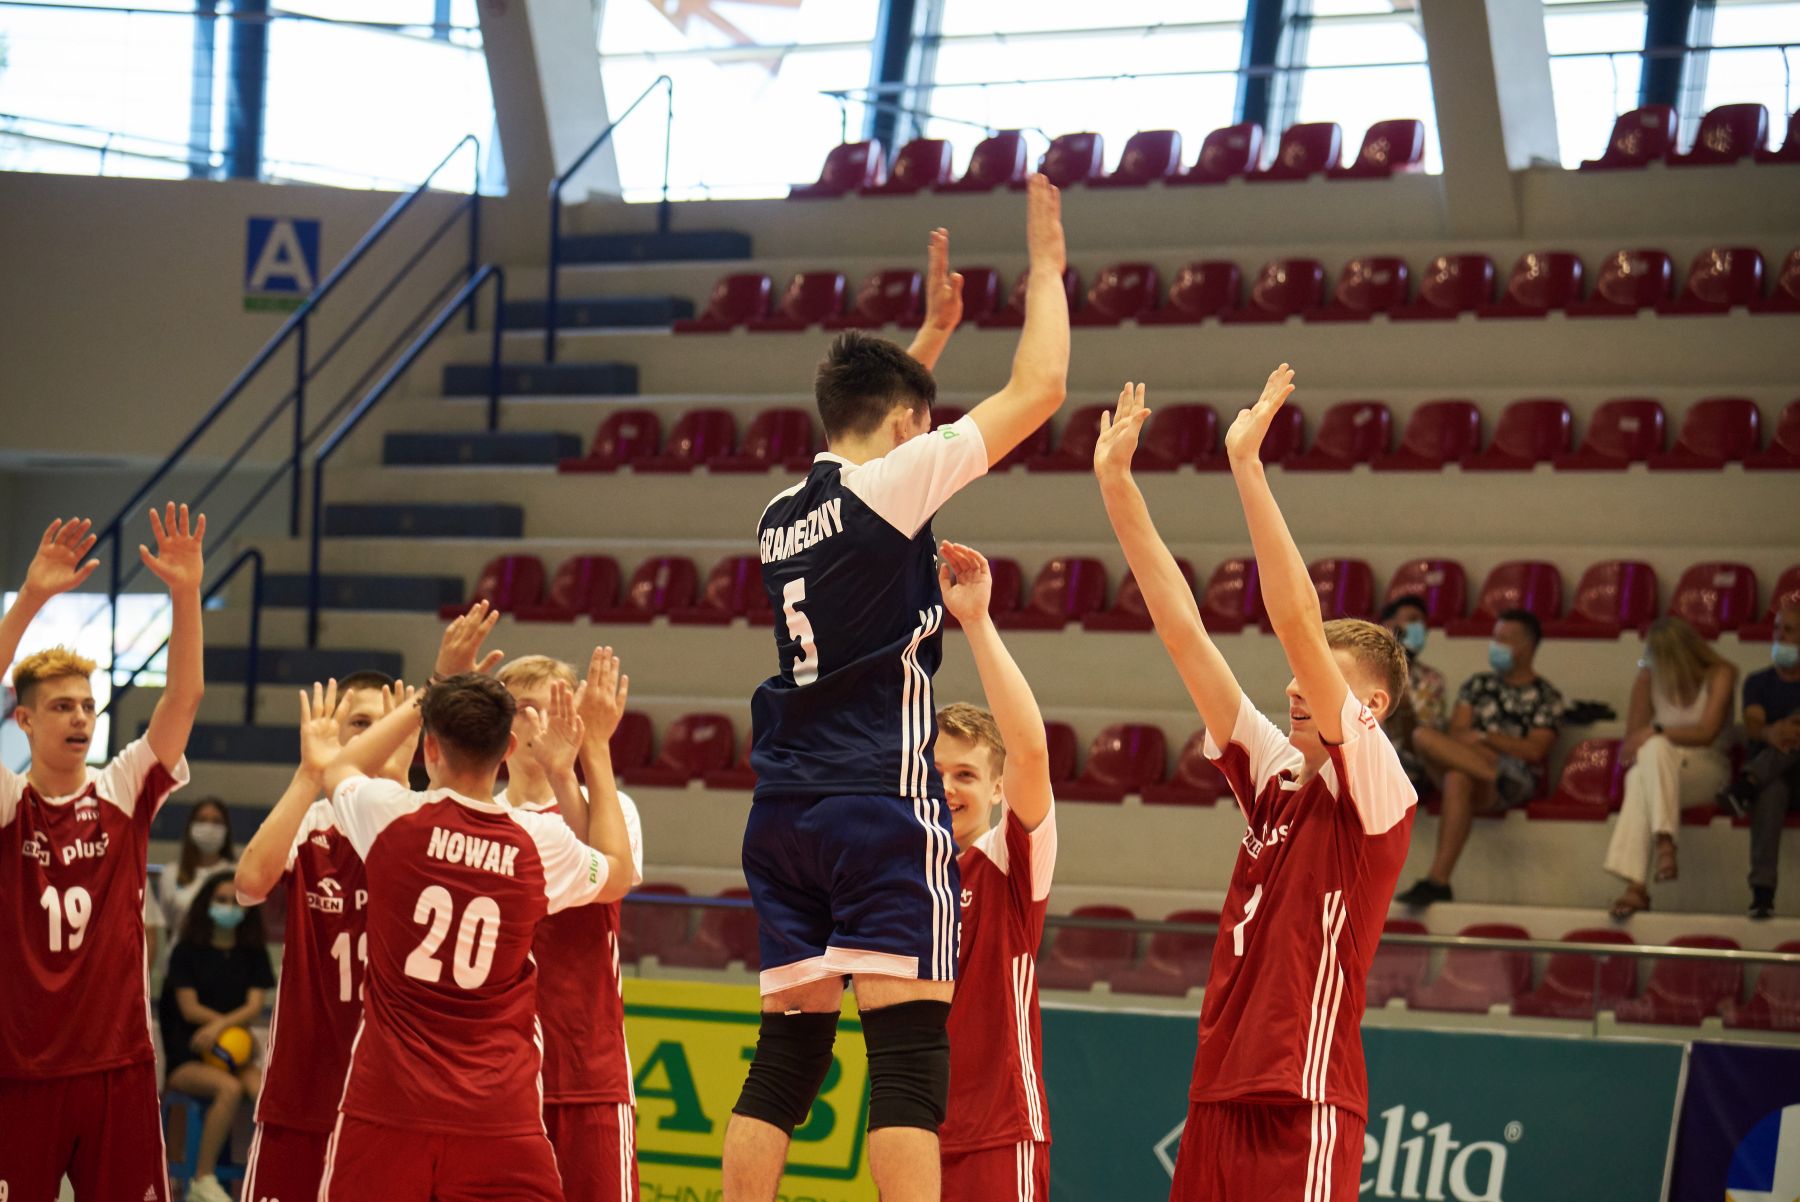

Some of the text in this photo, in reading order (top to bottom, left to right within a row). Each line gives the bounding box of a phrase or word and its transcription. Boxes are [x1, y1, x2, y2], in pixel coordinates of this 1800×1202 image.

[250, 219, 314, 290] A
[783, 577, 819, 687] 5
[62, 836, 106, 866] plus
[426, 826, 520, 877] NOWAK
[40, 885, 92, 952] 19
[404, 885, 501, 990] 20
[1233, 883, 1263, 957] 1
